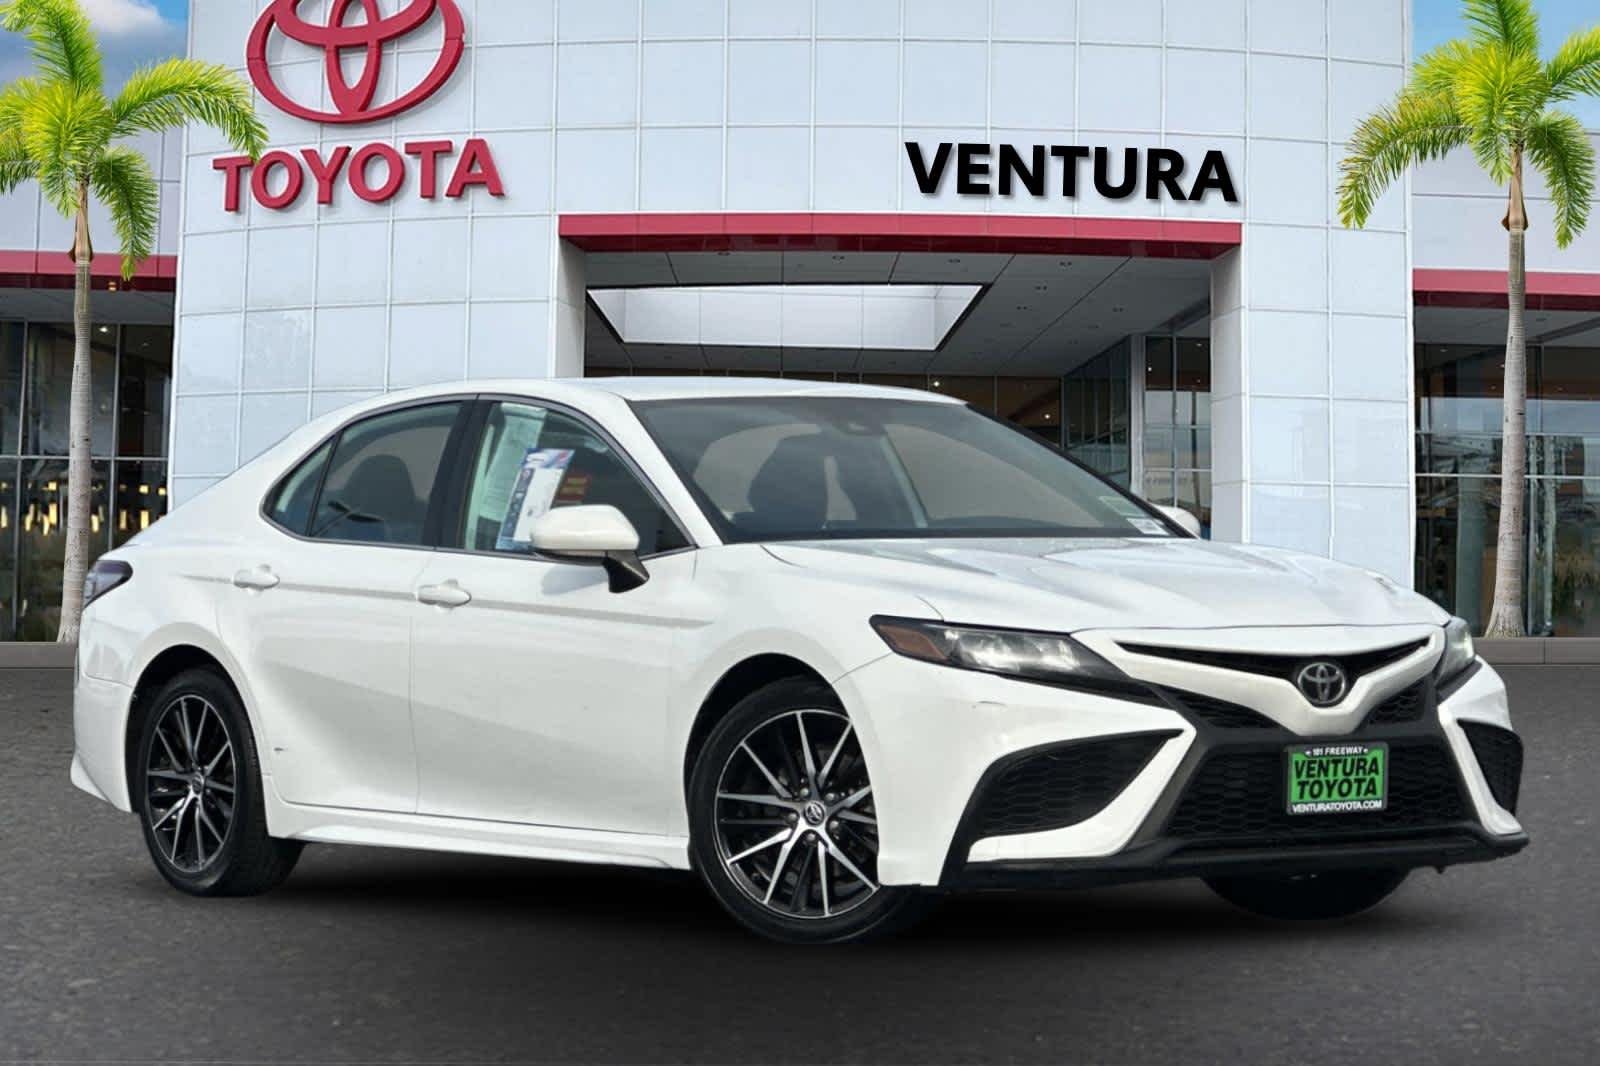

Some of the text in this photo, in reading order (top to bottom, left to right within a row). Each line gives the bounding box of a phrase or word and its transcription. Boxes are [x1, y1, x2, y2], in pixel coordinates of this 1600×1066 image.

[212, 138, 505, 212] TOYOTA
[904, 142, 1238, 202] VENTURA
[1325, 746, 1364, 755] FREEWAY
[1295, 757, 1379, 778] VENTURA
[1297, 778, 1377, 799] TOYOTA
[1292, 800, 1382, 813] VENTURATOYOTA.COM
